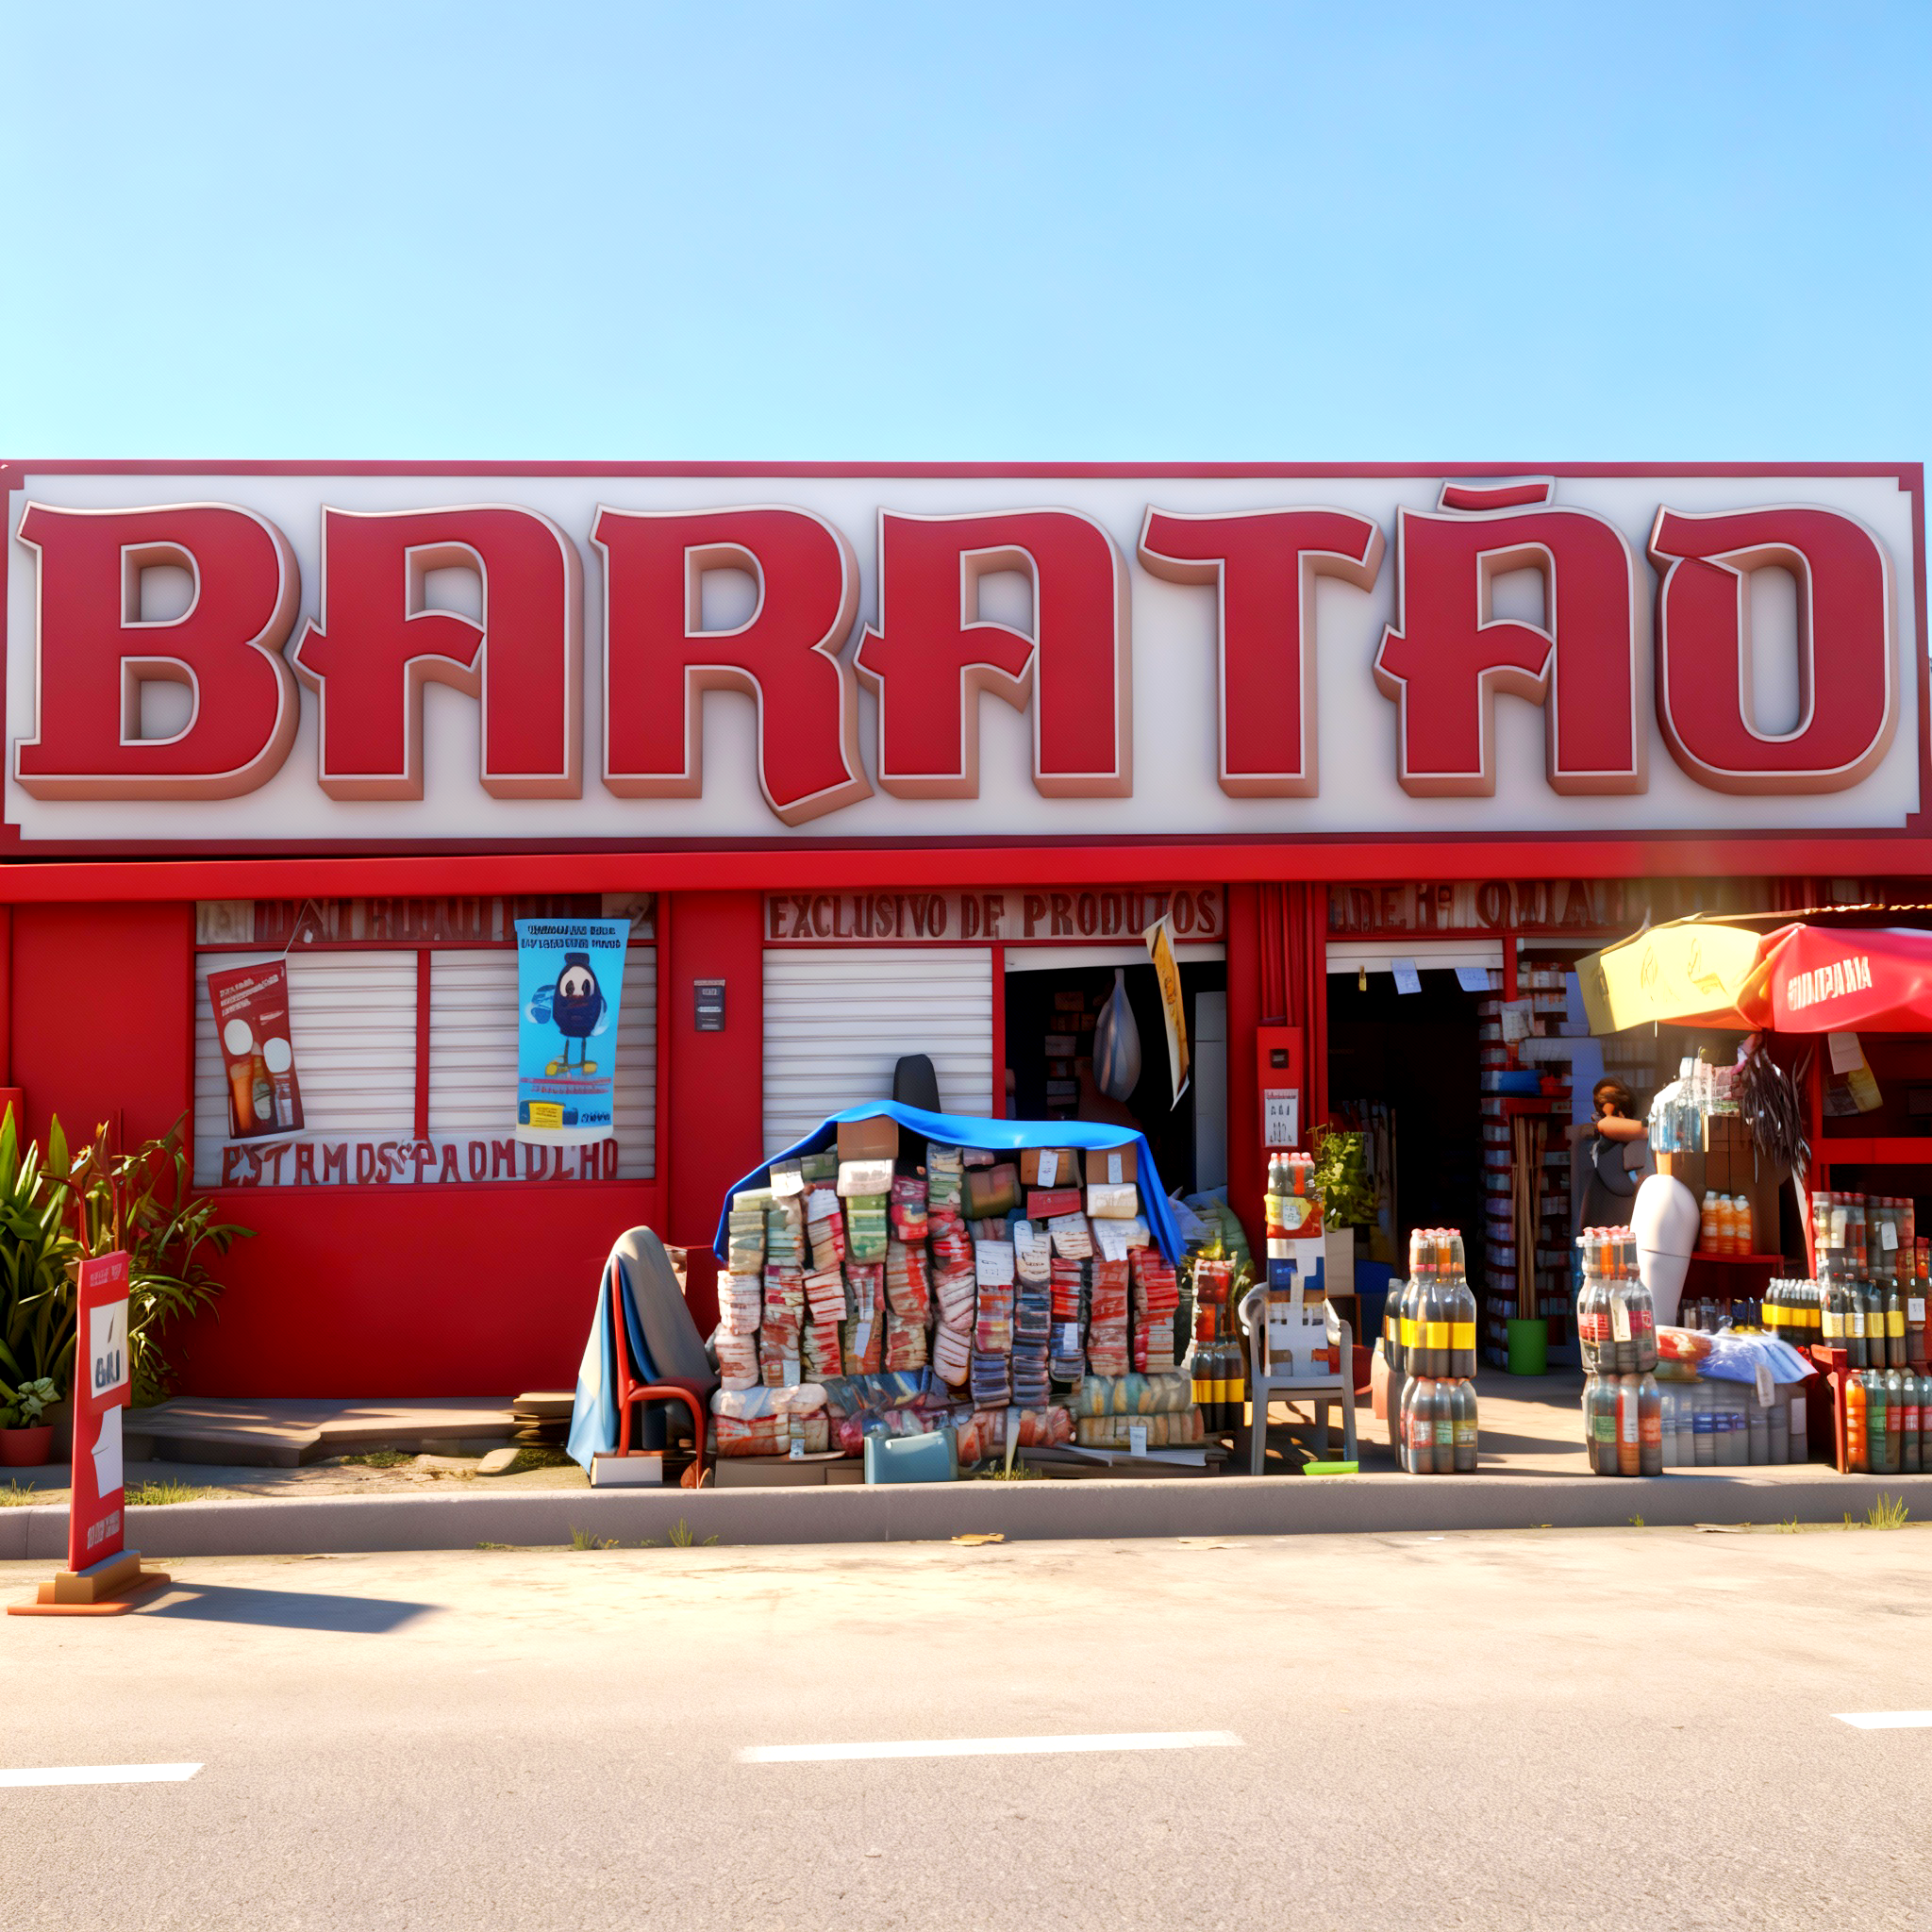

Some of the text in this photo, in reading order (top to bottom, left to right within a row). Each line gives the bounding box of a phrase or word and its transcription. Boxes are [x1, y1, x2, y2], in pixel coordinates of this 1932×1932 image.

[14, 475, 1900, 828] BARATÃO
[769, 892, 947, 939] EXCLUSIVO
[1024, 890, 1217, 937] PRODUTOS
